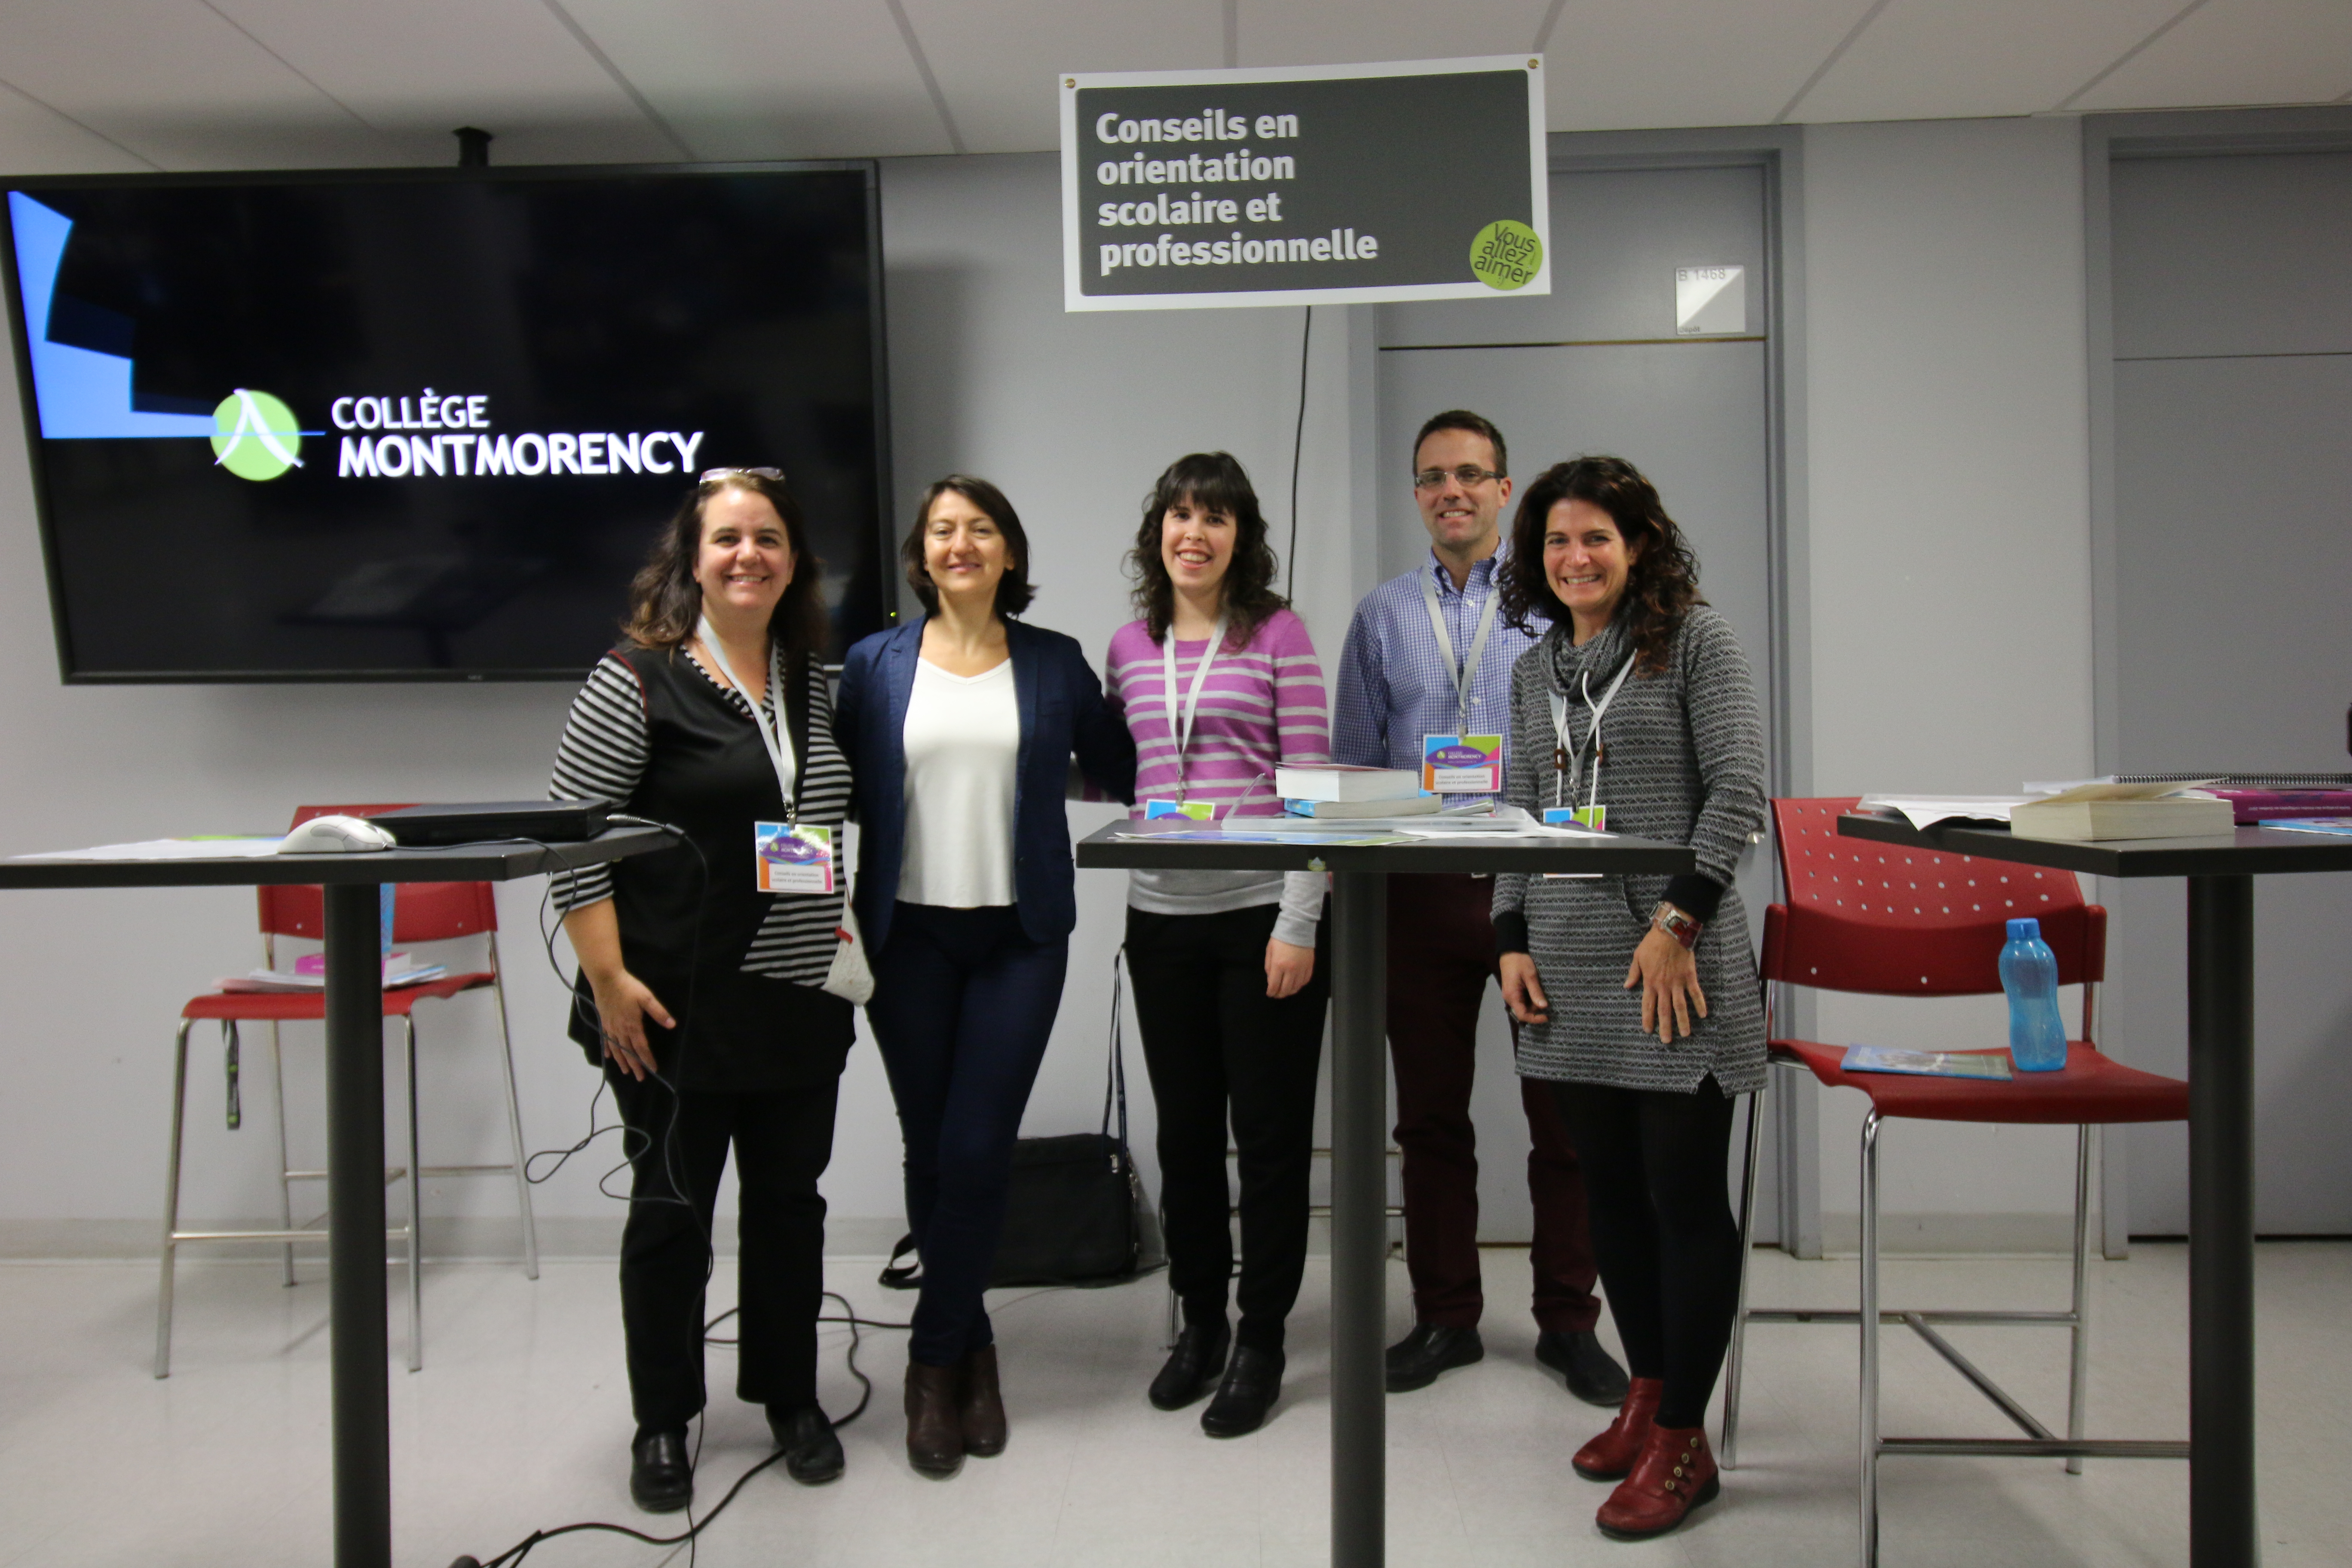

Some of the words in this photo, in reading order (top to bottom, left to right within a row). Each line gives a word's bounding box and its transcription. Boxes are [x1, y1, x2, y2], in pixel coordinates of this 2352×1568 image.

[1096, 108, 1247, 144] Conseils
[1255, 114, 1298, 139] en
[1097, 148, 1295, 185] orientation
[1098, 191, 1238, 227] scolaire
[1246, 192, 1282, 222] et
[1099, 228, 1378, 277] professionnelle
[1482, 239, 1528, 266] allez
[1494, 223, 1536, 252] Vous
[1474, 255, 1533, 285] aimer
[1678, 270, 1687, 281] B
[1695, 268, 1726, 281] 1468
[332, 388, 490, 430] COLLÈGE
[339, 431, 704, 478] MONTMORENCY
